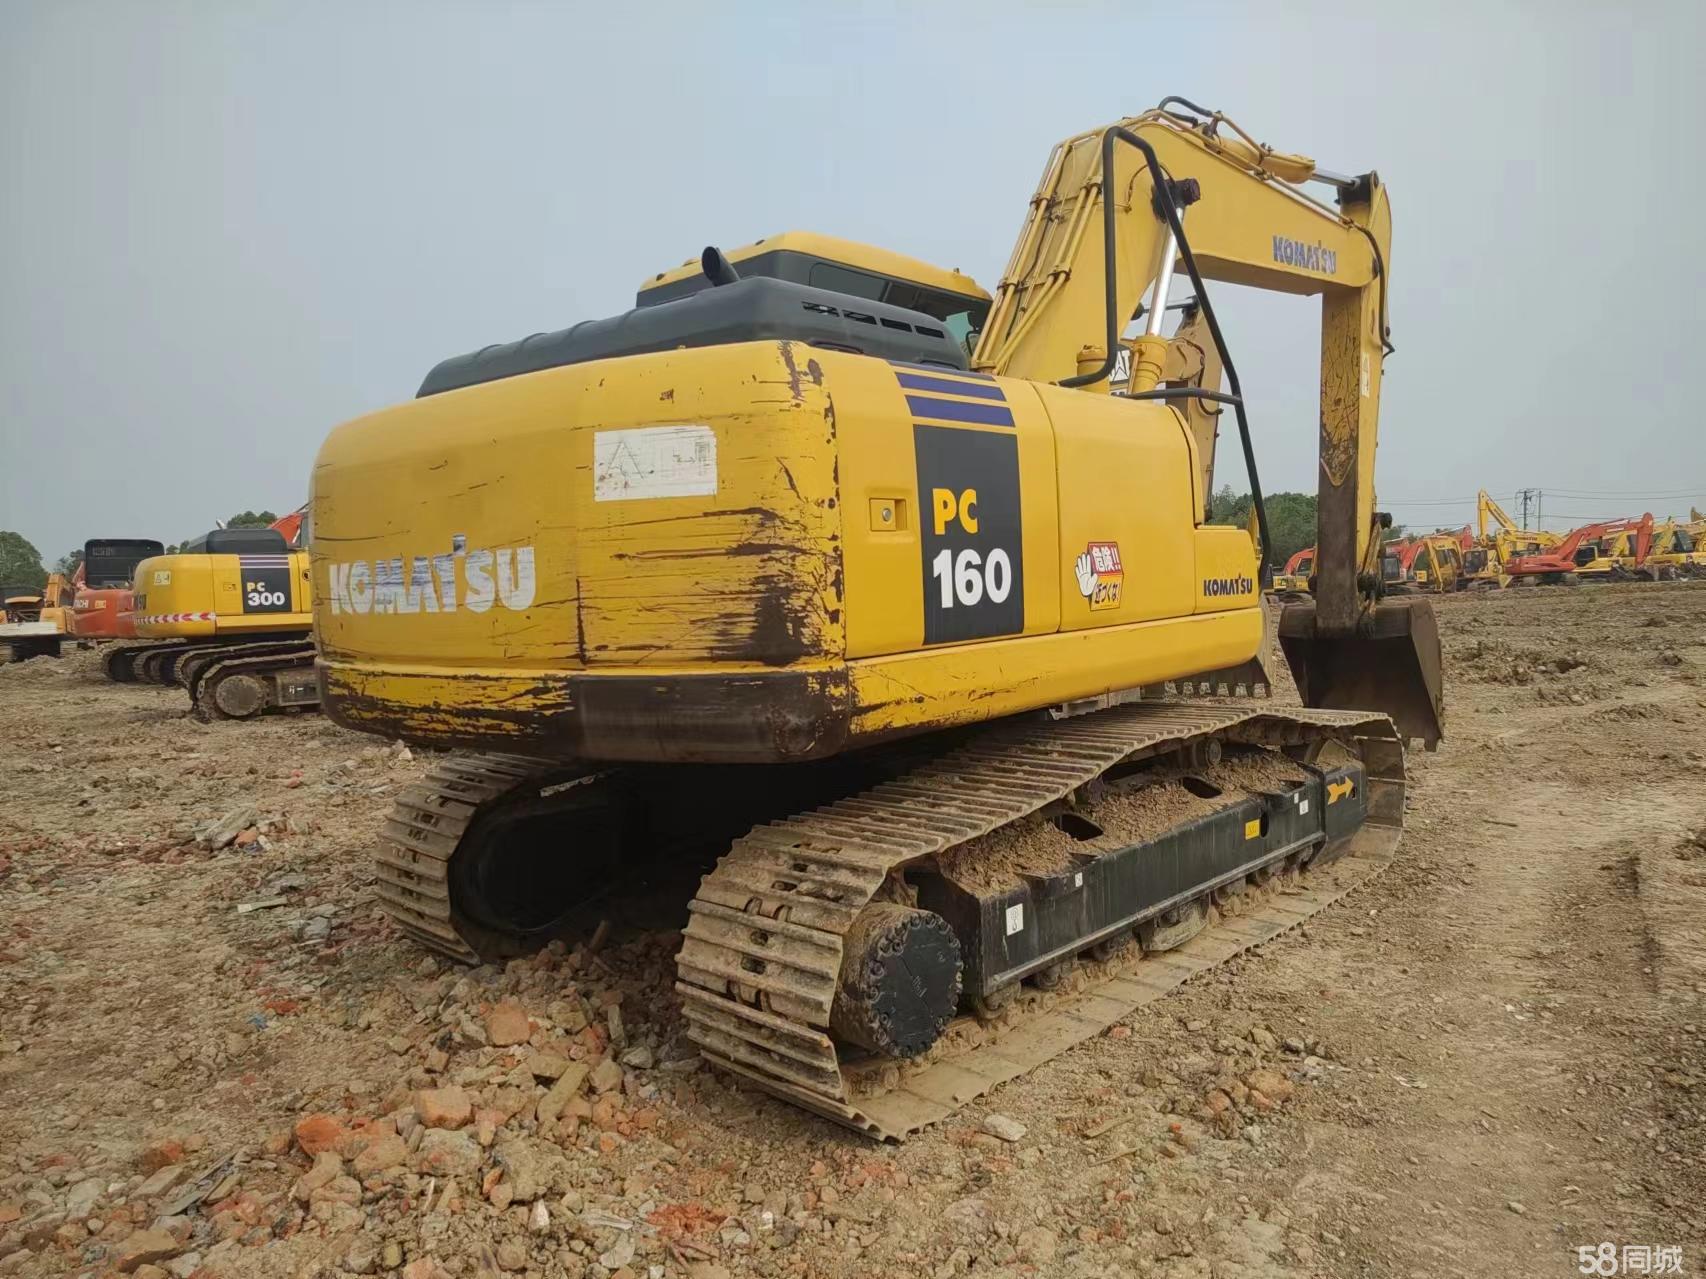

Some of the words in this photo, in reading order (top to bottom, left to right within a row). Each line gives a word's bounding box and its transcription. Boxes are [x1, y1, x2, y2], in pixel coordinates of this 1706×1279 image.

[1272, 235, 1337, 275] KOMATSU
[1109, 350, 1130, 382] AT
[932, 487, 979, 535] PC
[246, 582, 266, 592] PC
[329, 534, 536, 615] KOMATSU
[932, 547, 1012, 608] 160
[1203, 572, 1253, 597] KOMATSU
[247, 591, 286, 606] 300
